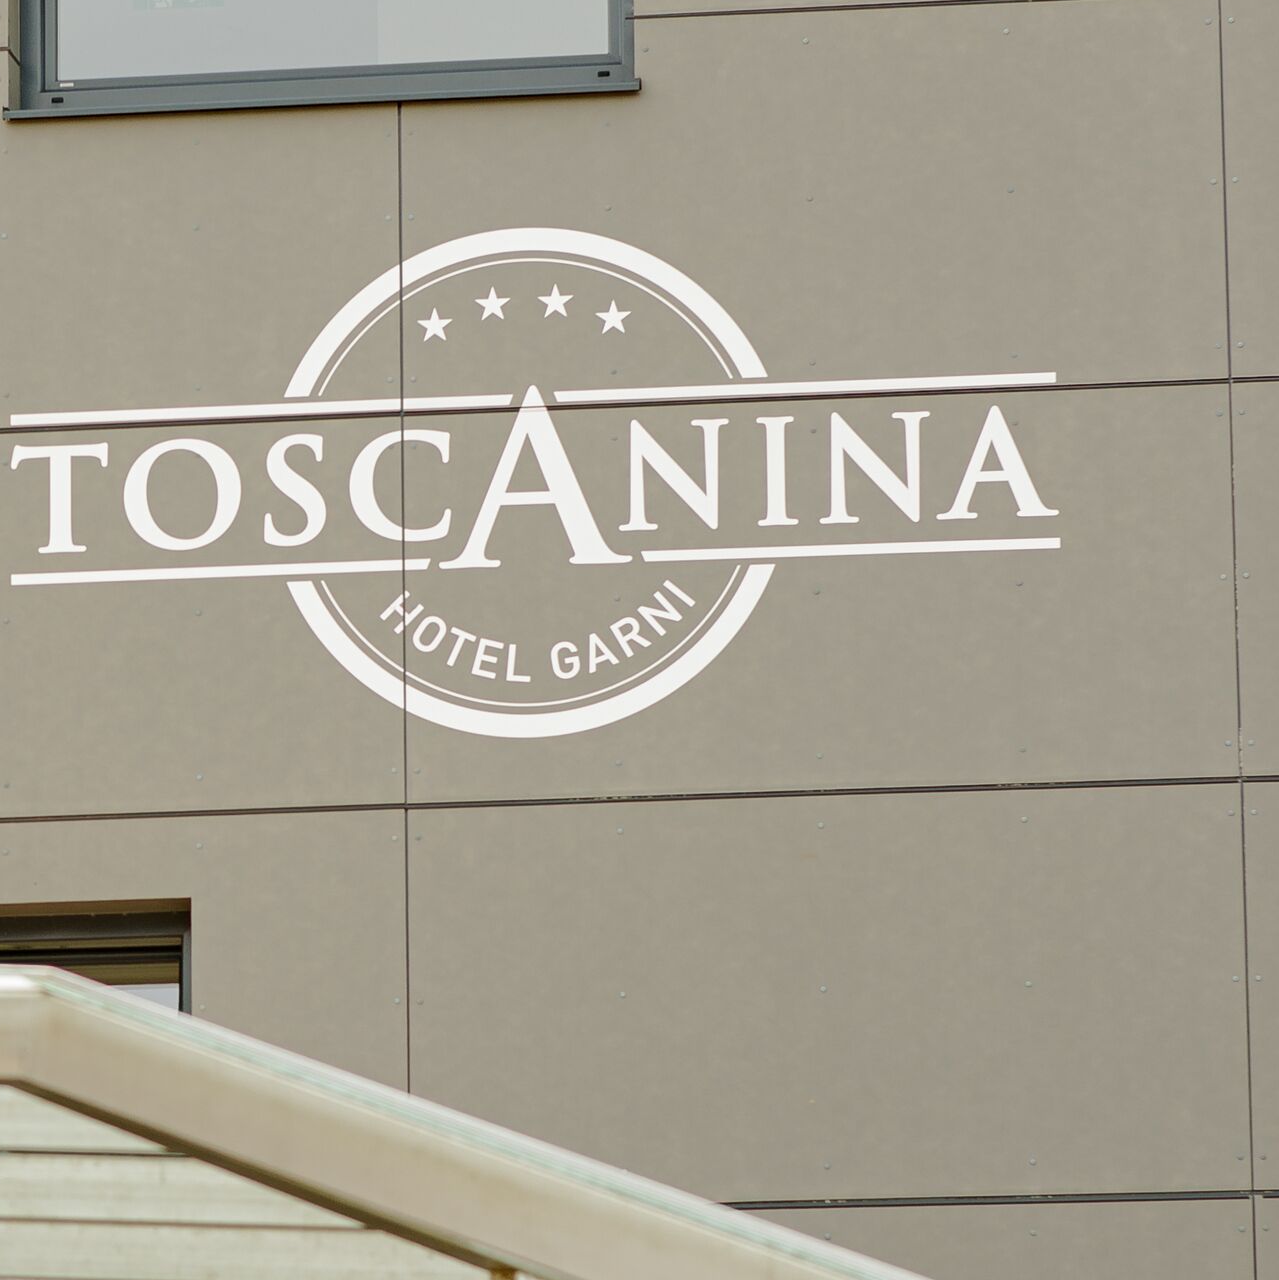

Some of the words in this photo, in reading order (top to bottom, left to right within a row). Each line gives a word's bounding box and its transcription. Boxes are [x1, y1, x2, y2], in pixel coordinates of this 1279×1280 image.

[10, 383, 1061, 571] TOSCANINA
[379, 589, 532, 684] HOTEL
[549, 578, 697, 681] GARNI
